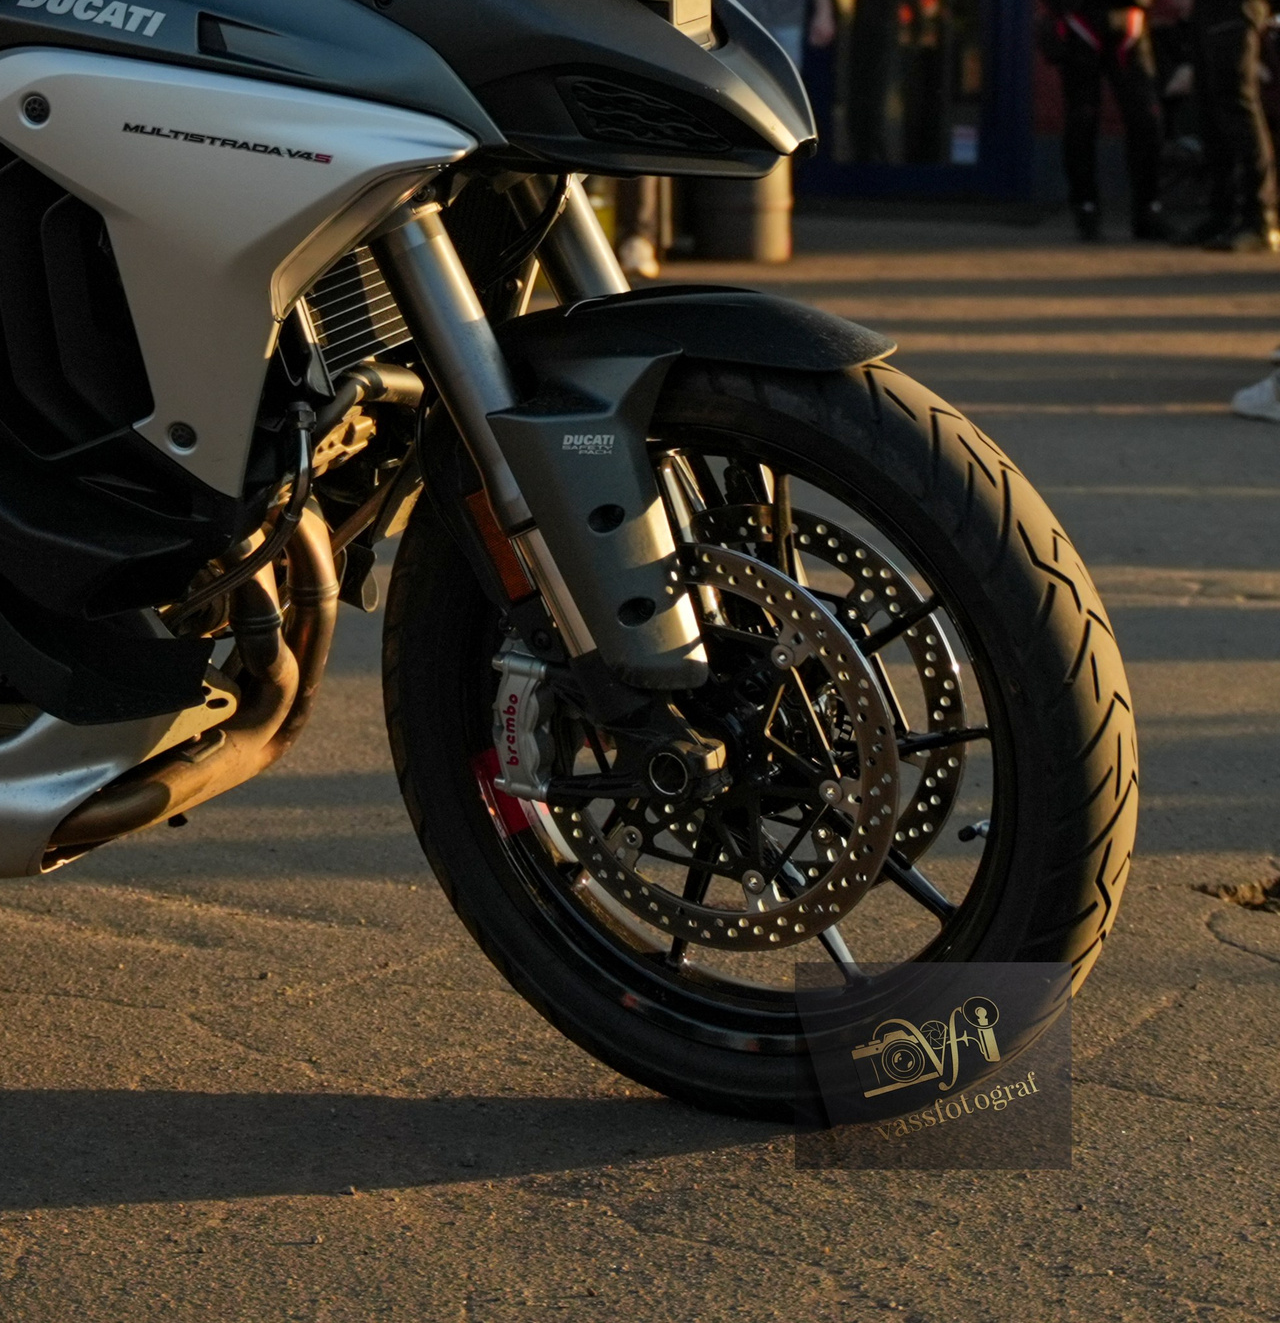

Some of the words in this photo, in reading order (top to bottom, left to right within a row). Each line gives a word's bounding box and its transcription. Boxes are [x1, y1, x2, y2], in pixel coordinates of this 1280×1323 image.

[122, 122, 283, 157] MULTISTRADA
[286, 148, 334, 165] V4S
[563, 434, 616, 445] DUCATI
[502, 693, 520, 766] brembo
